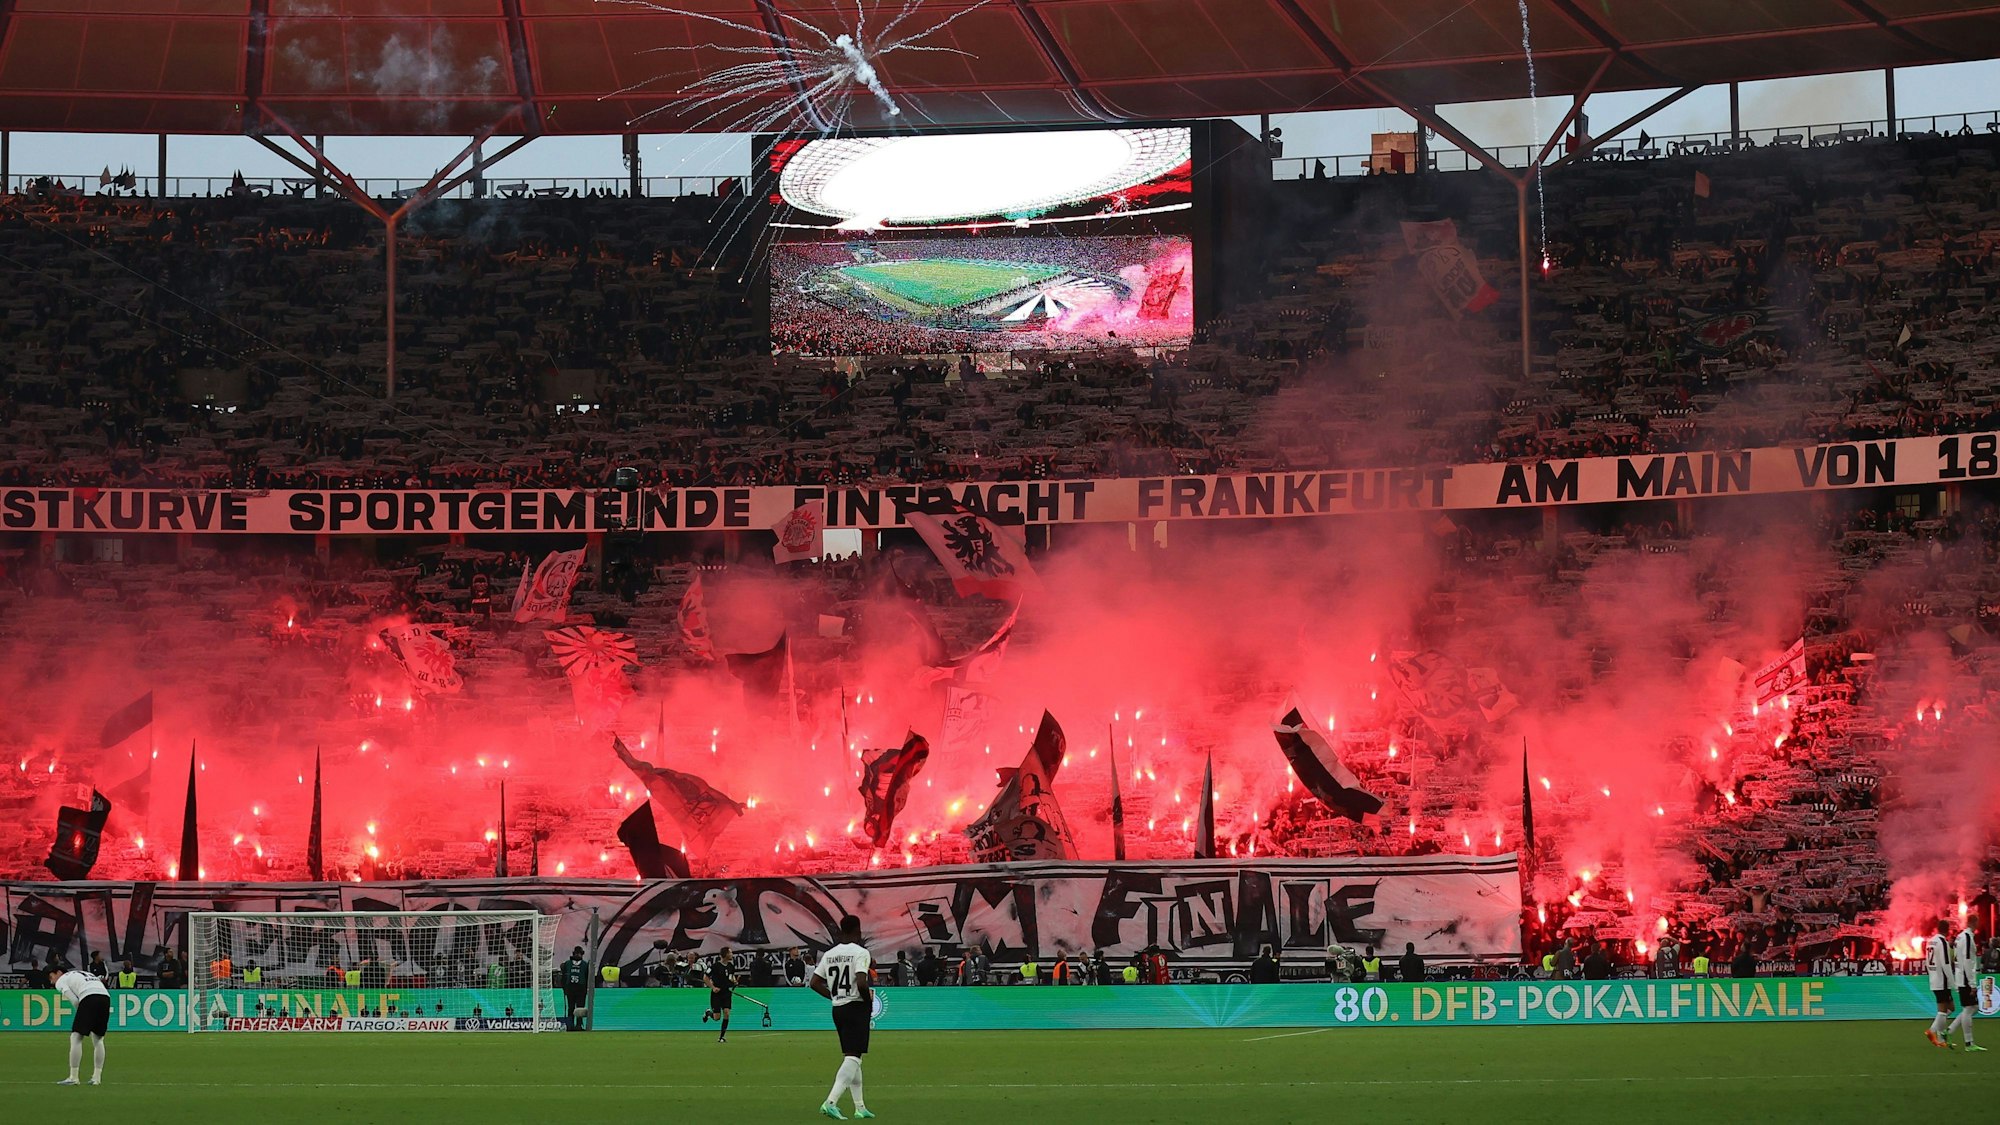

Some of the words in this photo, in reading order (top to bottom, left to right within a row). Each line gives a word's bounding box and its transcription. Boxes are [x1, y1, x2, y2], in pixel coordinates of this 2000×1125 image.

[0, 489, 247, 530] STKURVE
[289, 486, 750, 531] SPORTGEMEINDE
[1138, 467, 1453, 517] FRANKFURT
[1496, 460, 1579, 504] AM
[1617, 451, 1751, 499] MAIN
[1795, 441, 1897, 487] VON
[1938, 434, 1998, 479] 18
[828, 964, 852, 997] 24
[22, 993, 400, 1027] DF-POKALFINALE
[1333, 986, 1400, 1022] 80.
[1413, 980, 1825, 1023] DFB-POKALFINALE
[232, 1017, 339, 1030] FLYERALARM
[486, 1018, 562, 1033] Volkswagen
